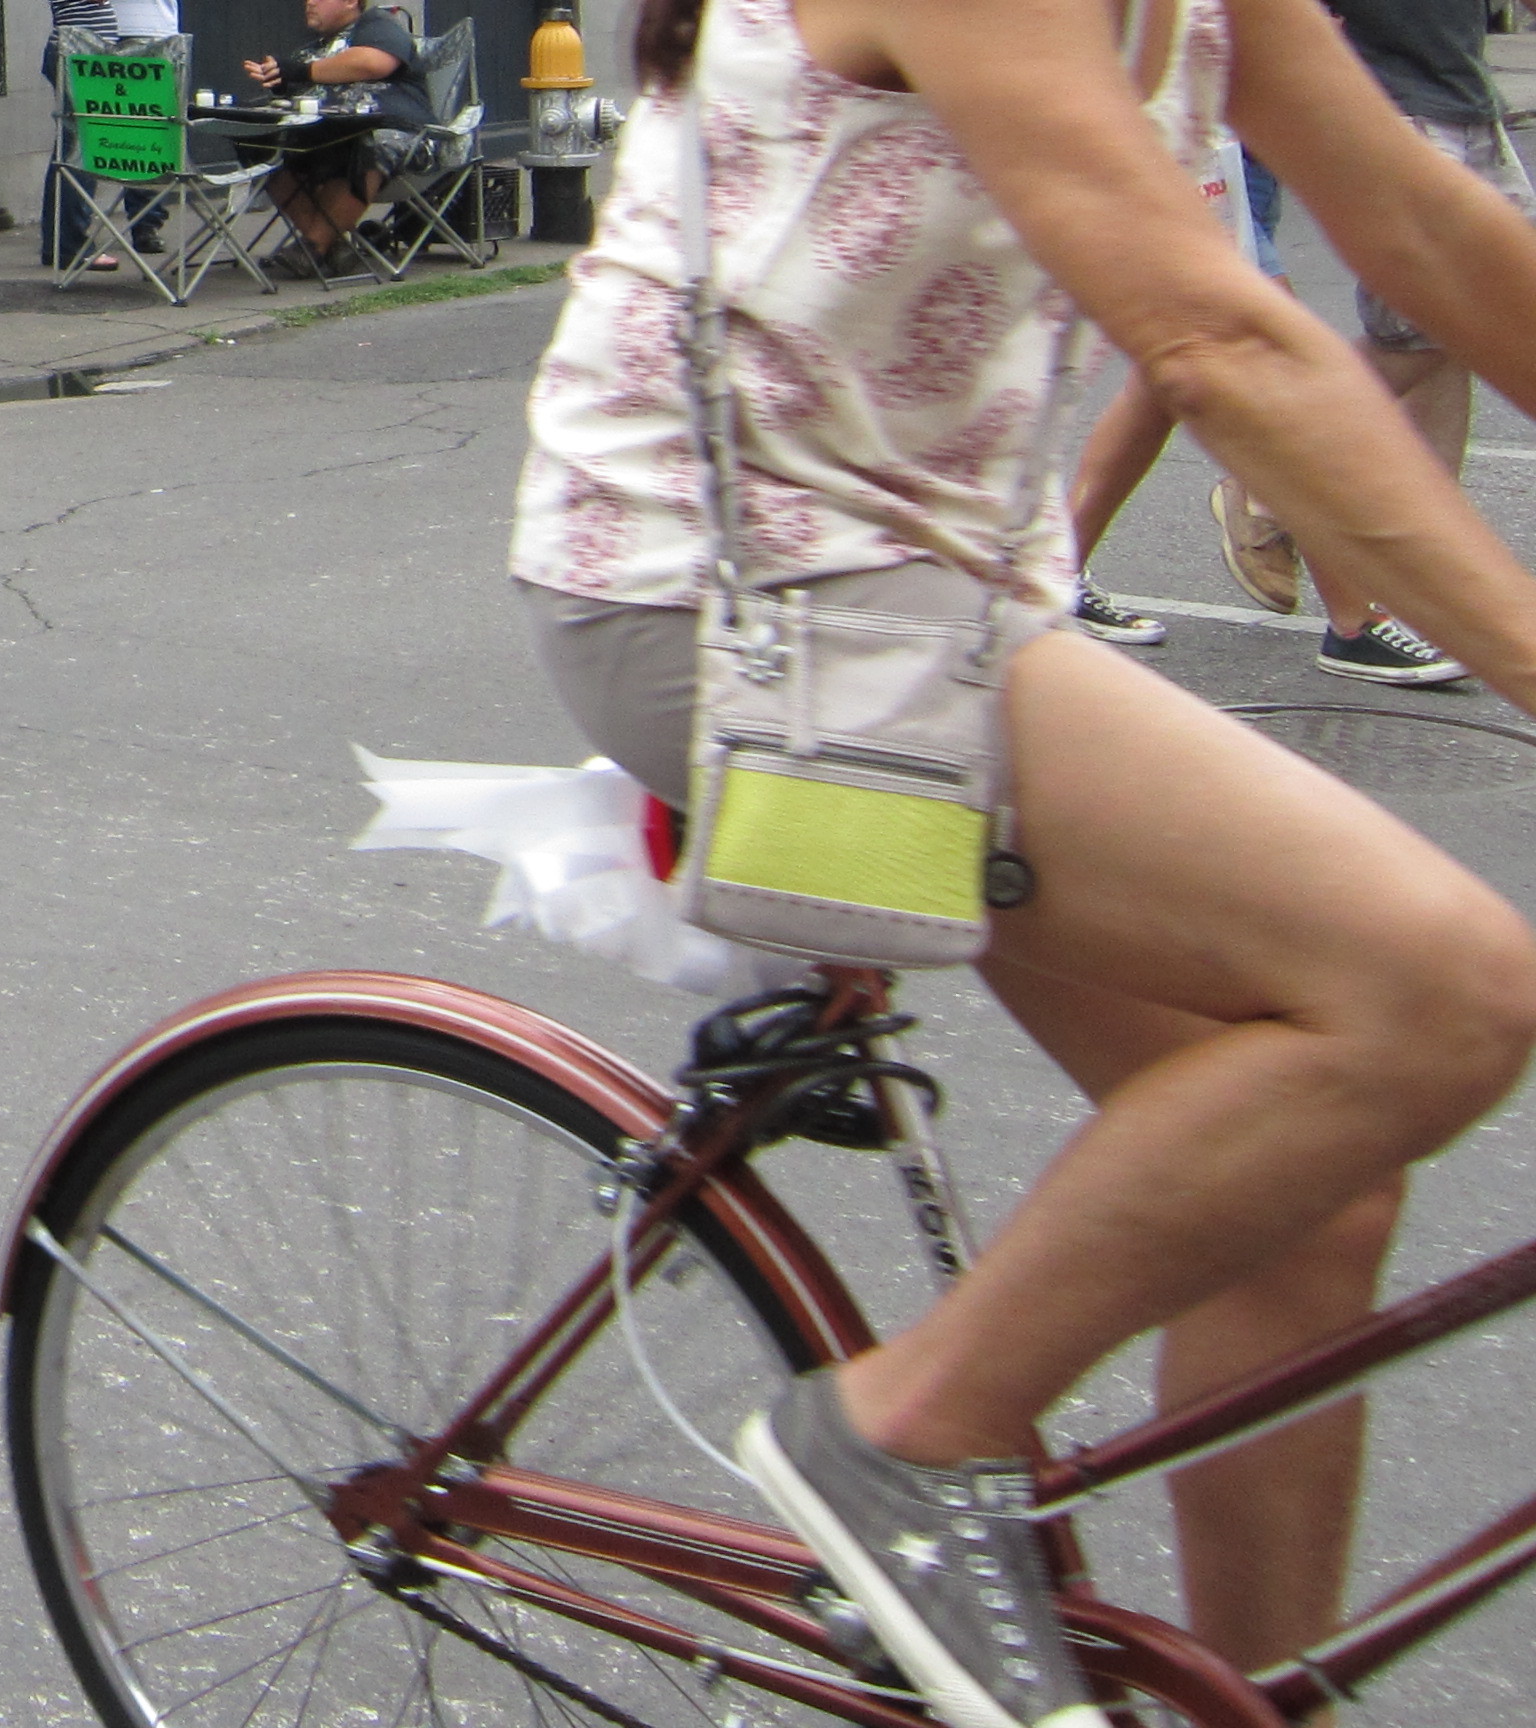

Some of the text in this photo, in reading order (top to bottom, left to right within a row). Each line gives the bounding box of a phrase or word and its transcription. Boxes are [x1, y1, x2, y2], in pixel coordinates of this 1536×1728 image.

[71, 59, 166, 81] TAROT
[115, 83, 127, 97] &
[85, 99, 164, 119] PALMS
[98, 137, 163, 154] Readings by
[93, 155, 176, 175] DAMIAN
